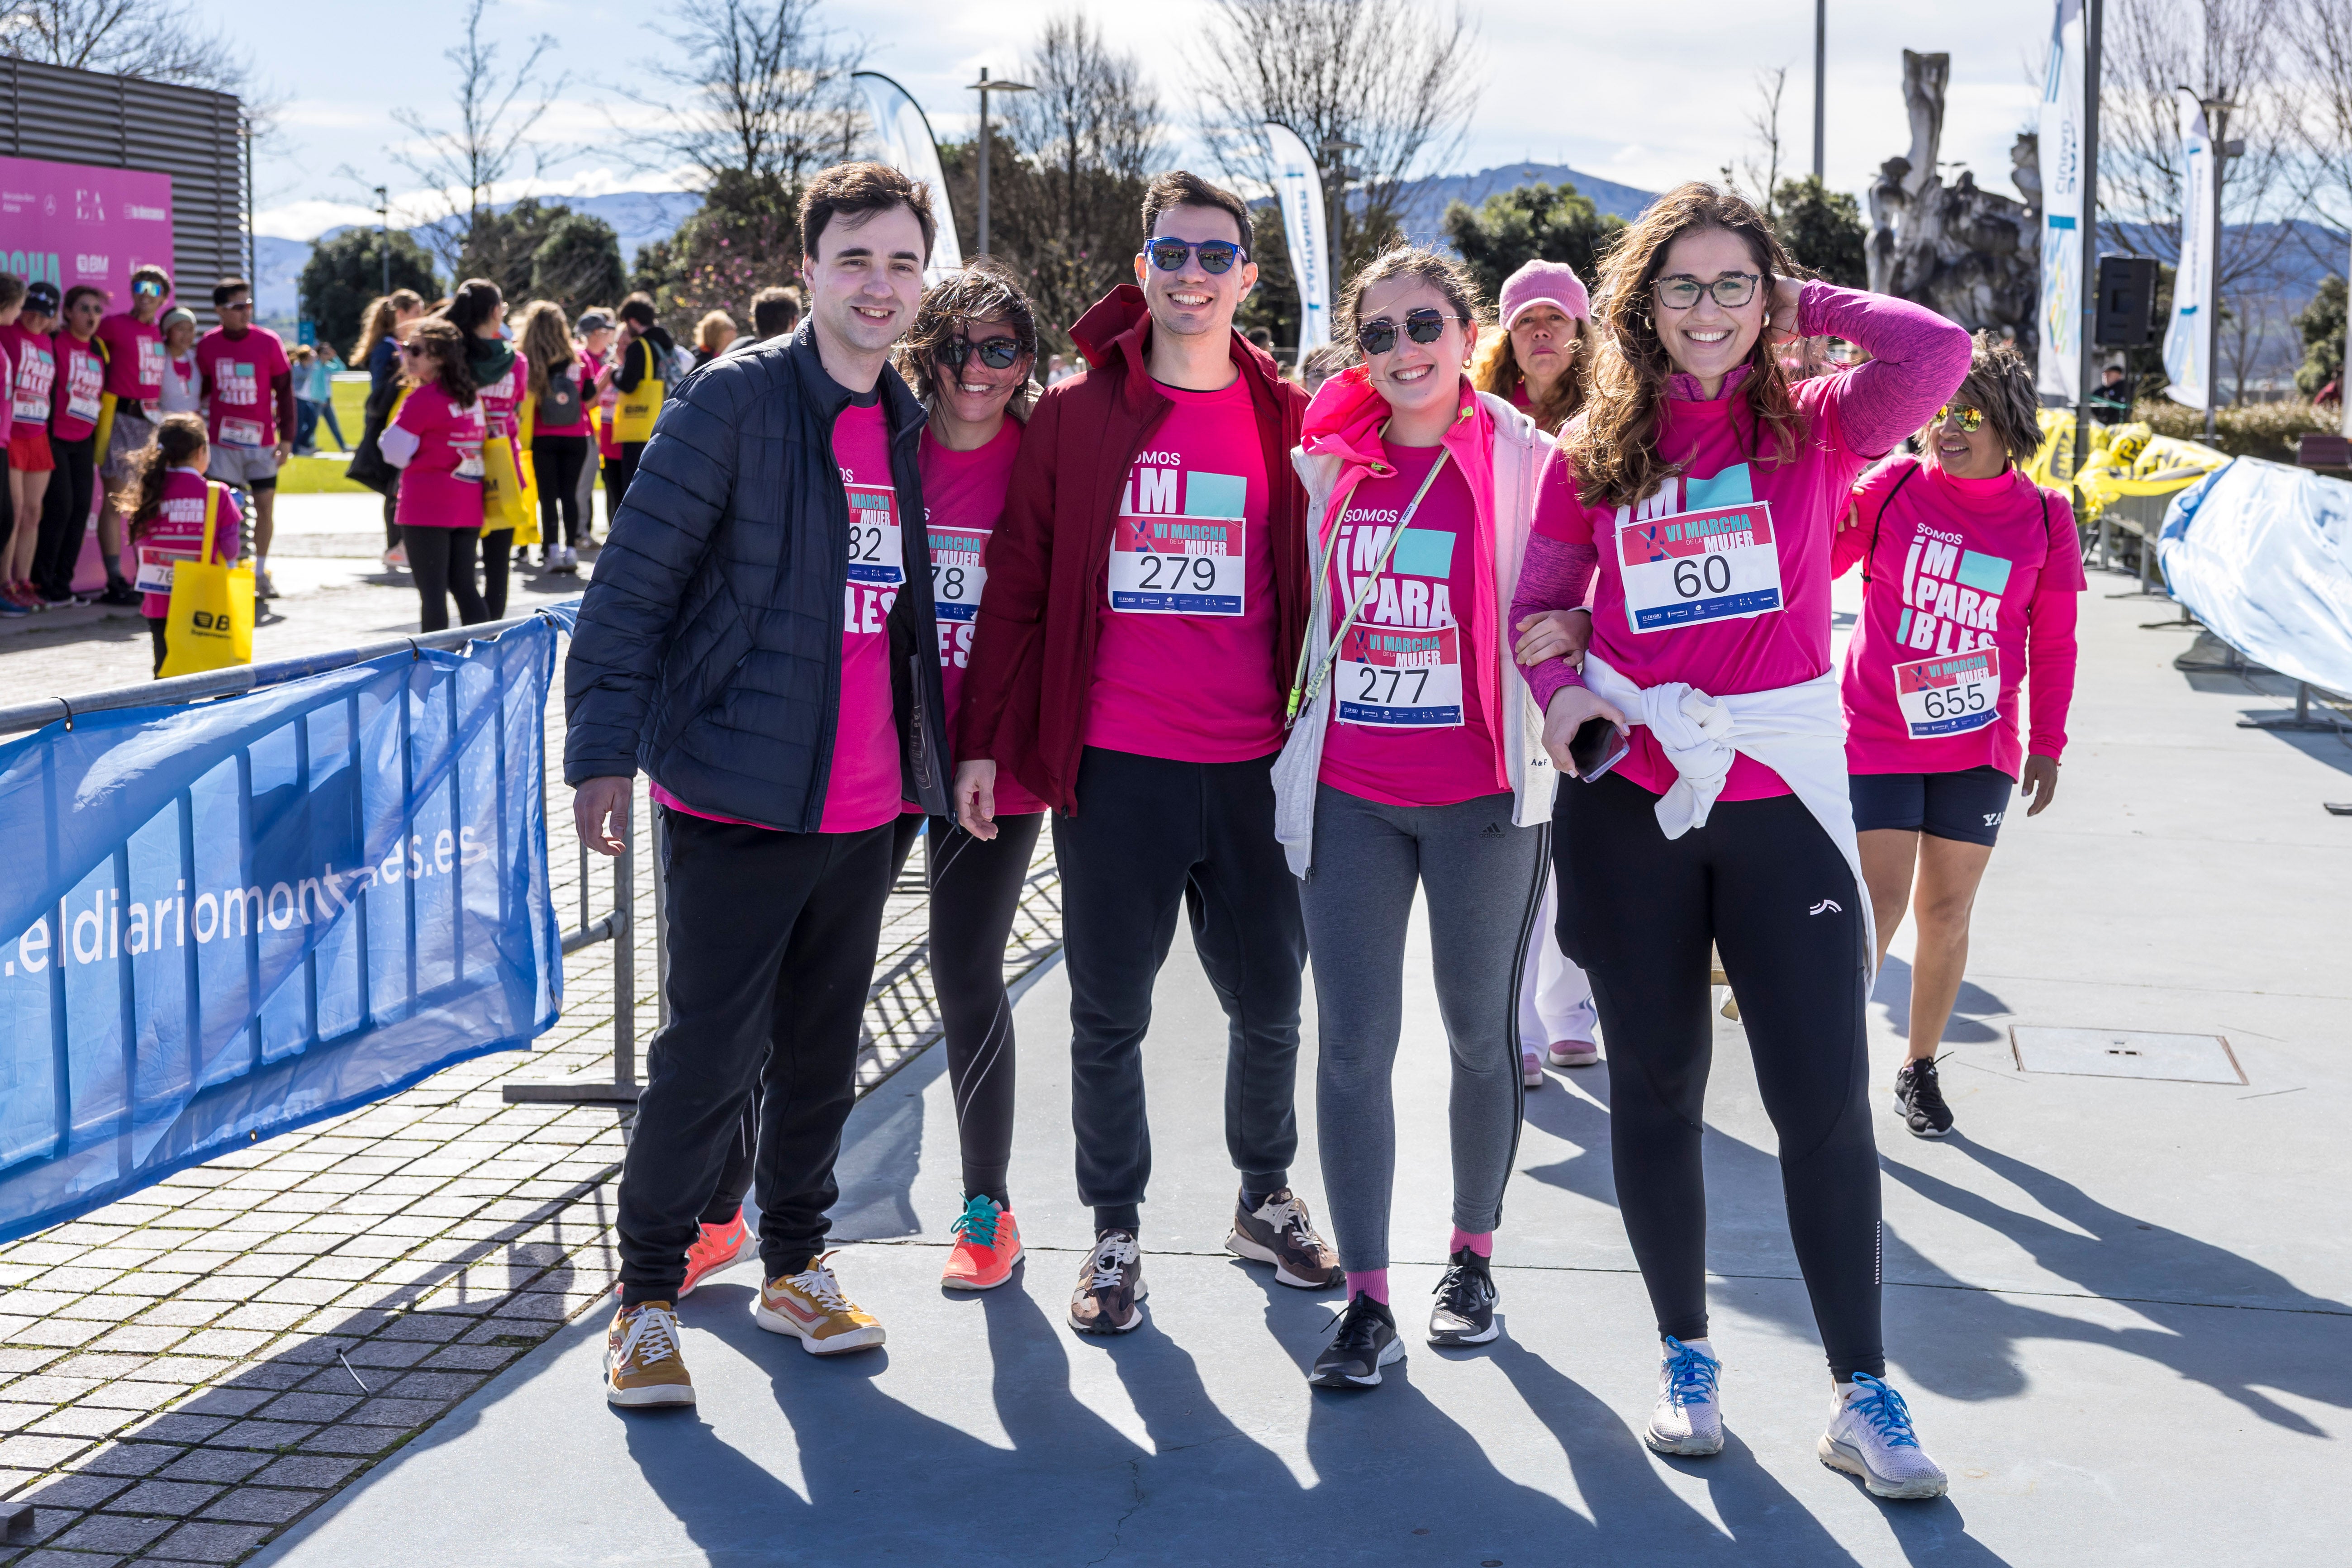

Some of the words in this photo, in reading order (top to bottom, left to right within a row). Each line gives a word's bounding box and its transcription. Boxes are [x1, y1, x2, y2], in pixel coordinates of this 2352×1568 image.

[851, 493, 890, 510] MARCHA
[860, 509, 890, 526] MUJER
[1344, 508, 1398, 523] SOMOS
[1154, 523, 1168, 538] VI
[1171, 524, 1227, 541] MARCHA
[1665, 524, 1682, 542] VI
[1685, 514, 1752, 539] MARCHA
[1917, 523, 1963, 545] SOMOS
[1185, 540, 1227, 556] MUJER
[1703, 530, 1755, 553] MUJER
[936, 550, 979, 567] MUJER
[1139, 556, 1216, 591] 279
[1673, 555, 1730, 598] 60
[1353, 575, 1456, 627] PARA
[1916, 576, 2001, 631] PARA
[1369, 634, 1381, 650] VI
[1385, 635, 1440, 653] MARCHA
[1396, 651, 1441, 667] MUJER
[1928, 665, 1941, 678] VI
[1942, 655, 1988, 675] MARCHA
[1359, 667, 1429, 704] 277
[1955, 667, 1990, 684] MUJER
[1925, 683, 1985, 718] 655
